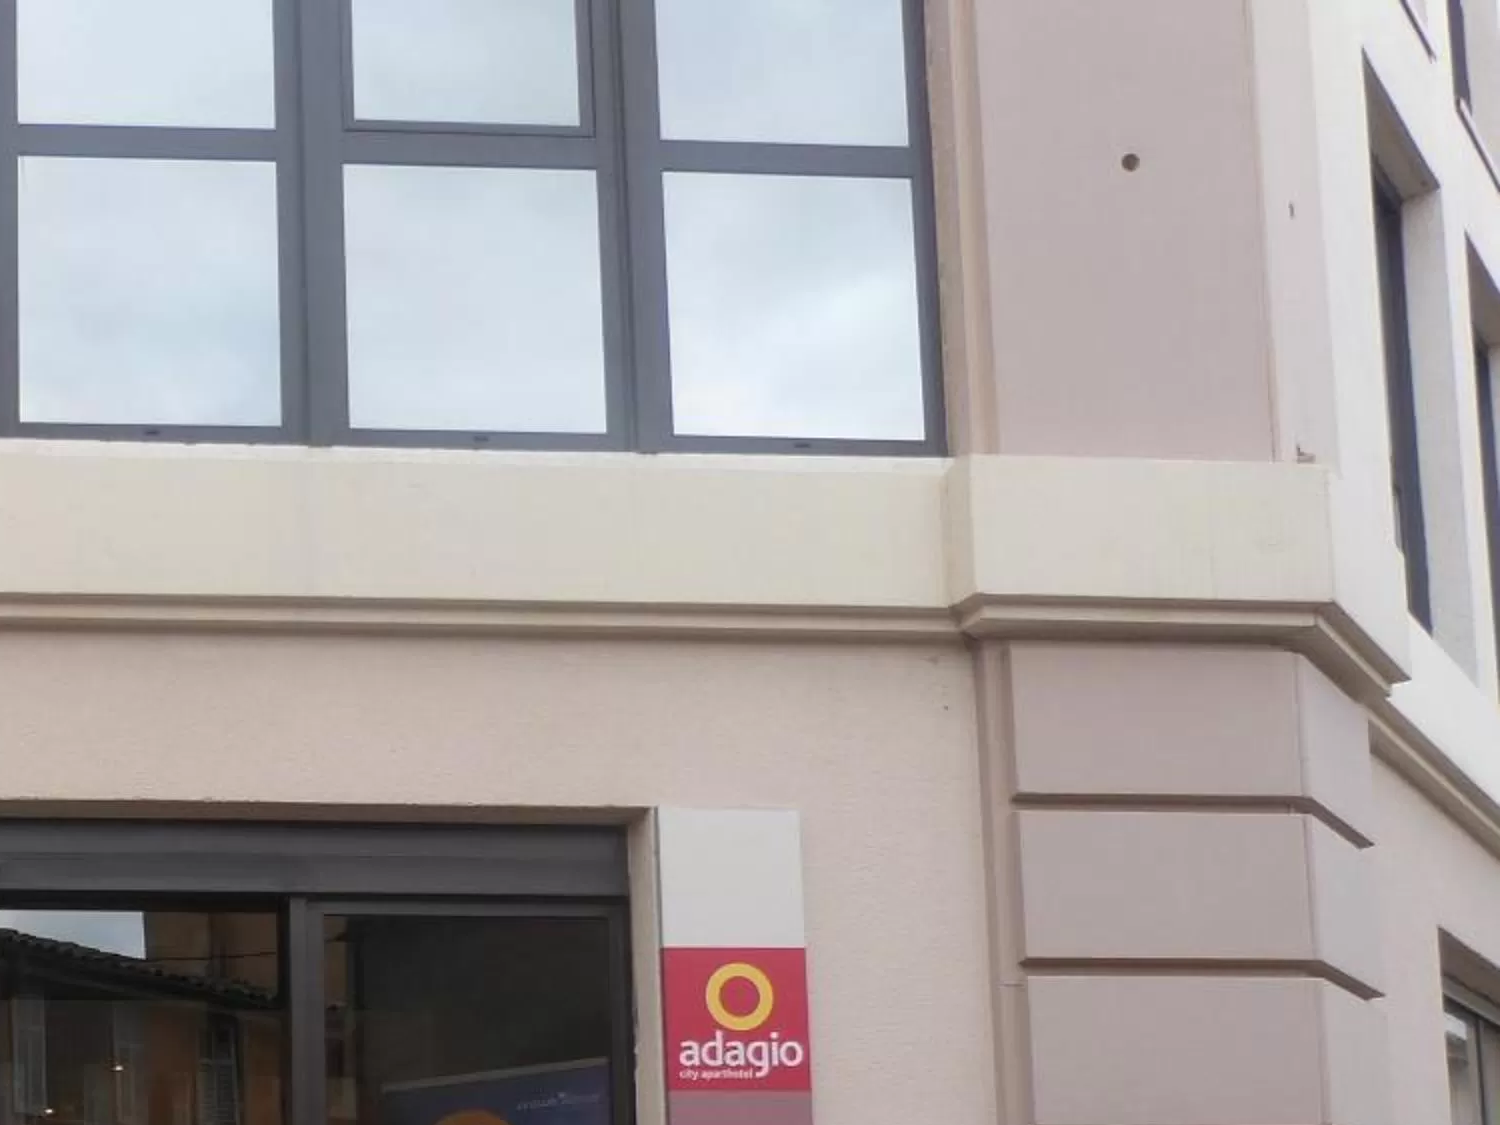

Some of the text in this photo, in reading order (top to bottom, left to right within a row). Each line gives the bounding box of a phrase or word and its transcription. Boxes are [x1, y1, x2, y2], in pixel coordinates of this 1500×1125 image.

[679, 1030, 804, 1078] adagio
[679, 1068, 753, 1081] city aparthotel
